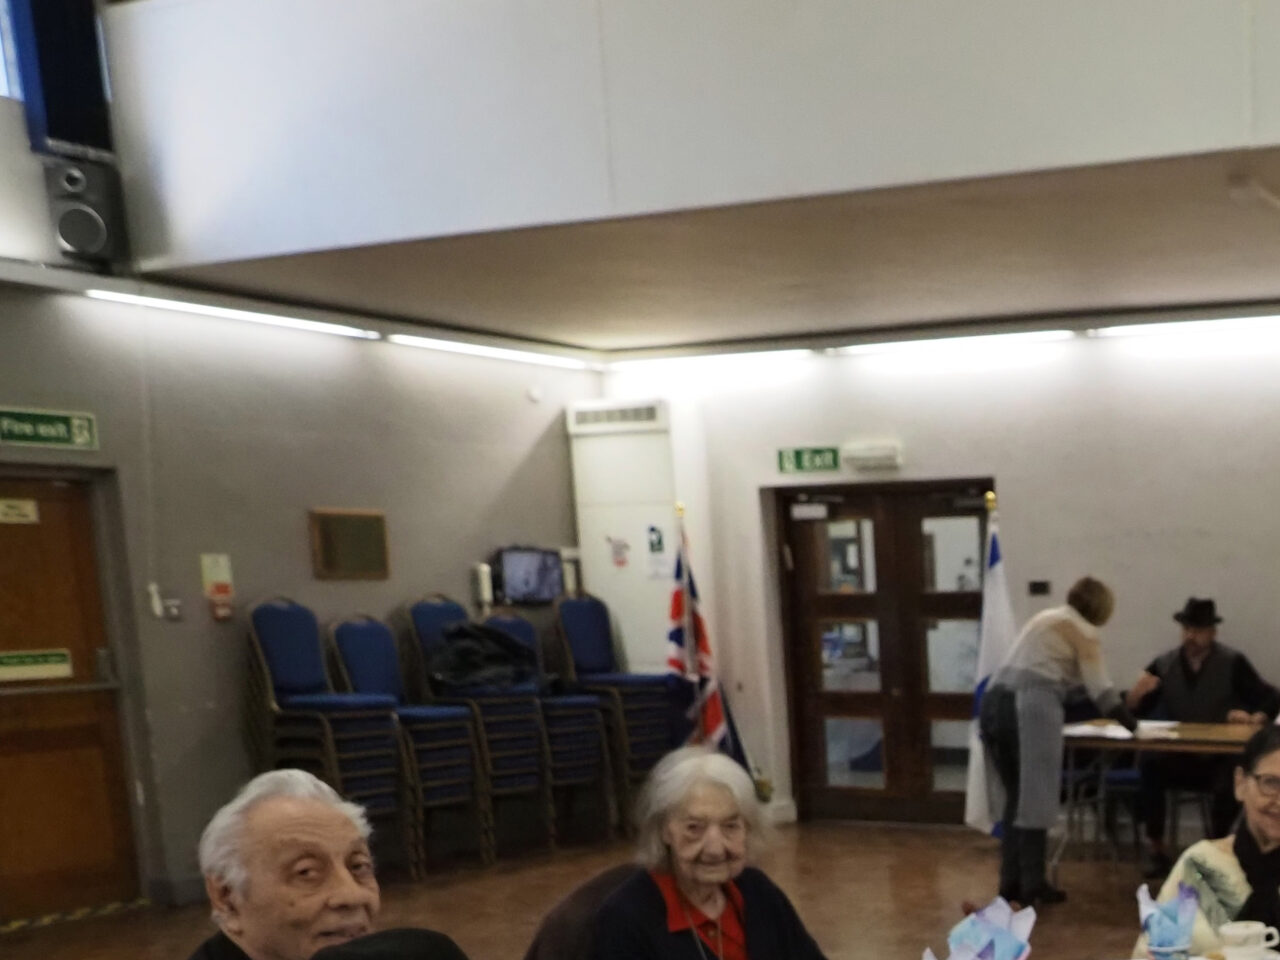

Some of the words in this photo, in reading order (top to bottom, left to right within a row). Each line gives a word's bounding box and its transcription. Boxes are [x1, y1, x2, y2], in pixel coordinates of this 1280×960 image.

[0, 416, 34, 436] Fire
[36, 421, 69, 438] exit
[802, 451, 833, 469] Exit
